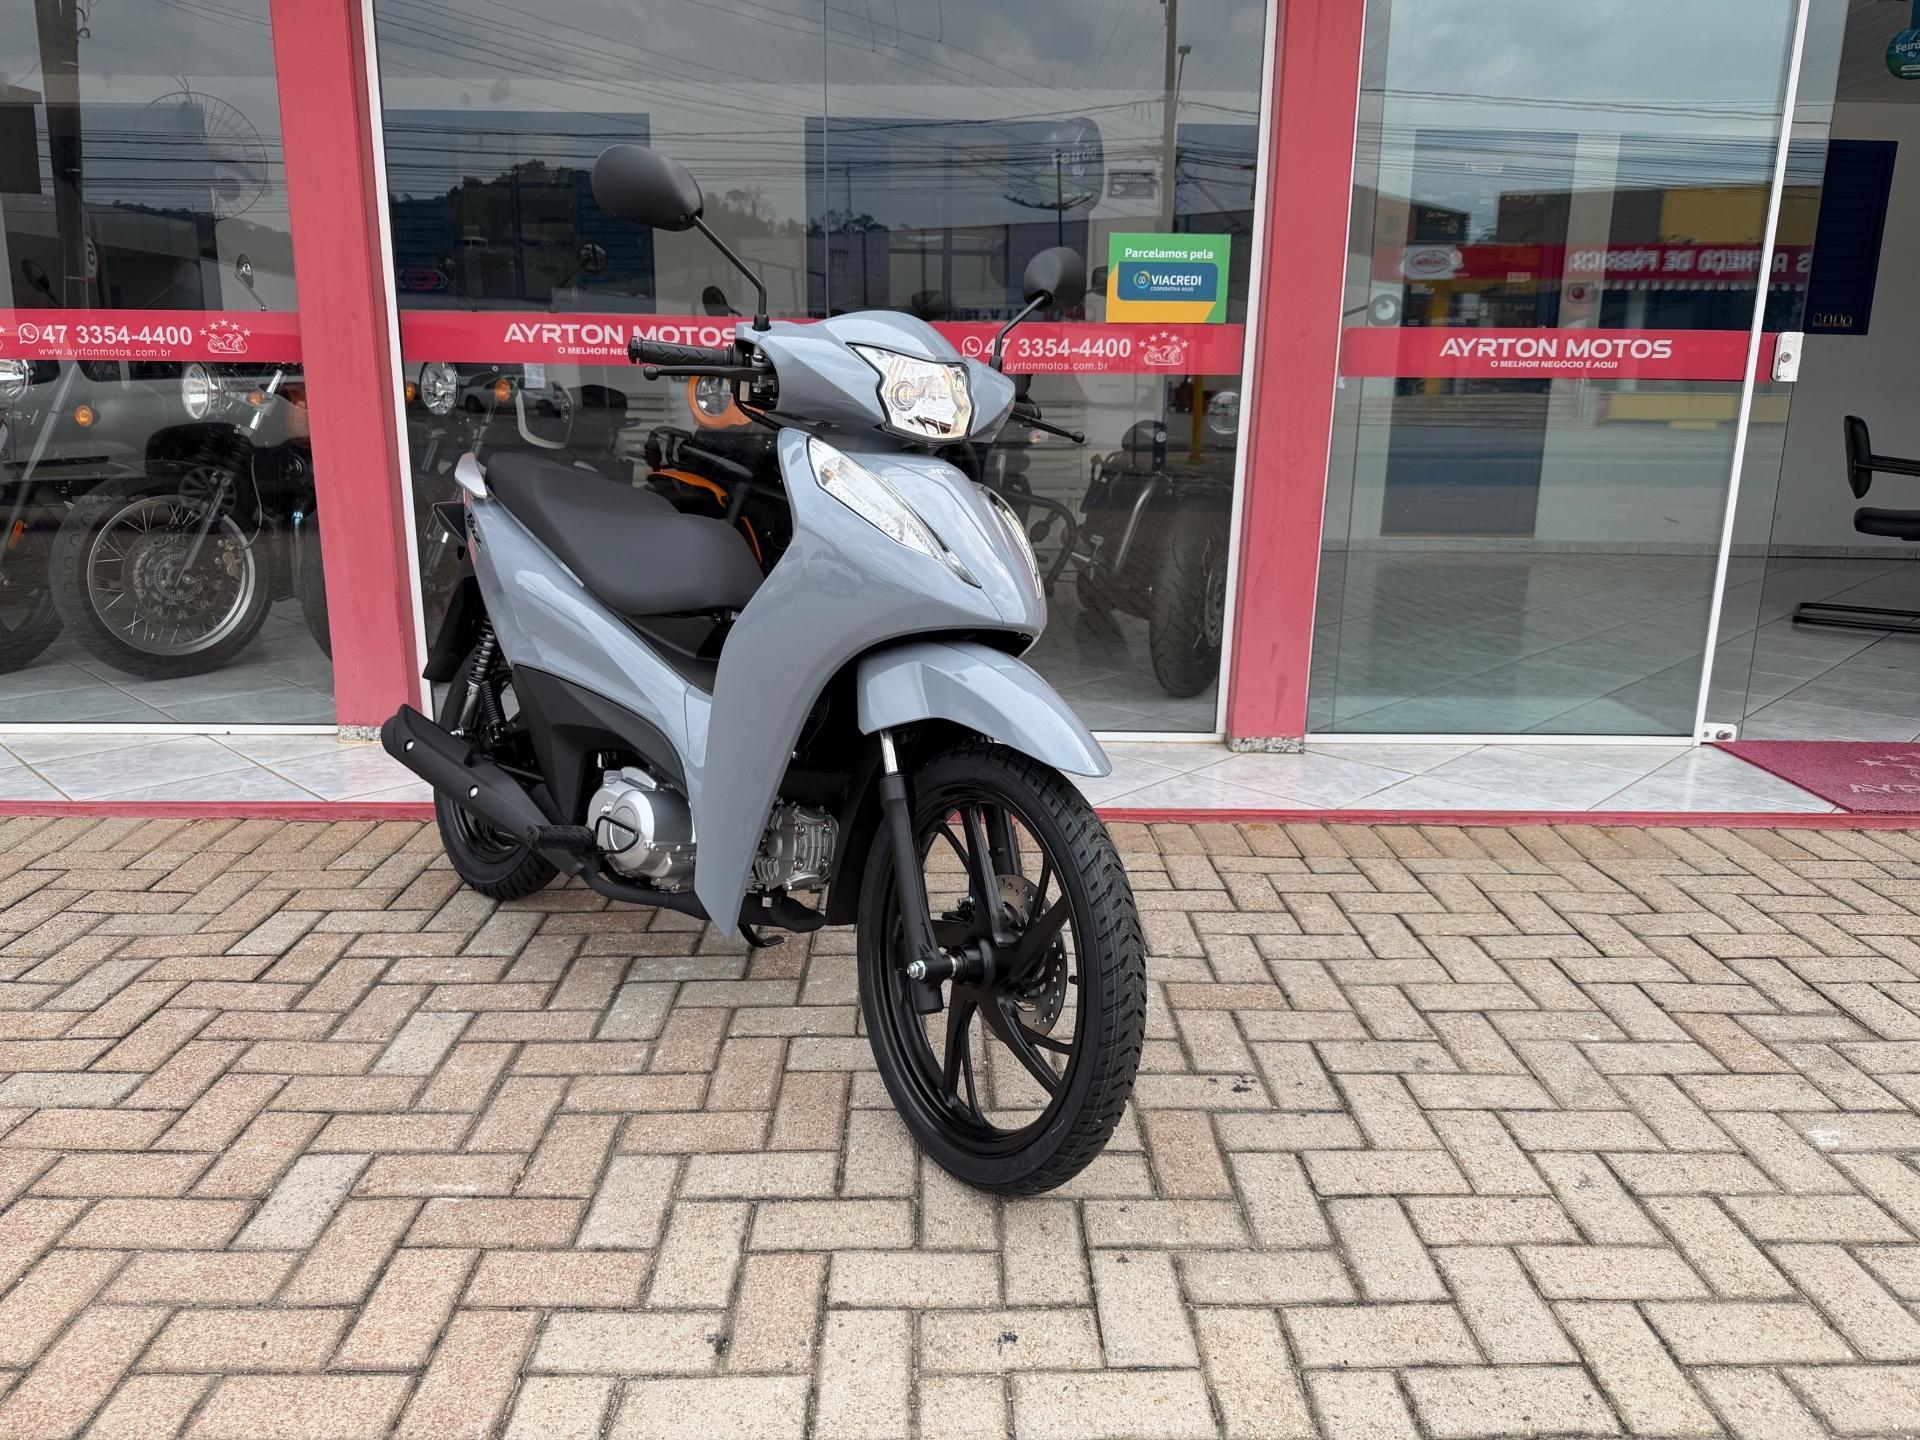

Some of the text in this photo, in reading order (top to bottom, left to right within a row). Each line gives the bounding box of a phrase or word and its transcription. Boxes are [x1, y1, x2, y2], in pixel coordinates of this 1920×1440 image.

[1125, 247, 1214, 261] Parcelamos pela
[1151, 274, 1202, 286] VIACREDI
[41, 324, 193, 346] 47 3354-4400
[503, 323, 735, 347] AYRTON MOTOS
[38, 347, 172, 358] www.ayrtonmotos.com.br
[558, 346, 566, 354] O
[567, 347, 609, 355] MELHOR
[1018, 338, 1132, 358] 3354-4400
[1439, 337, 1673, 359] AYRTON MOTOS
[1490, 360, 1498, 368] O
[1500, 360, 1539, 368] MELHOR
[1541, 359, 1584, 369] NEGÓCIO
[1593, 360, 1618, 369] AQUI
